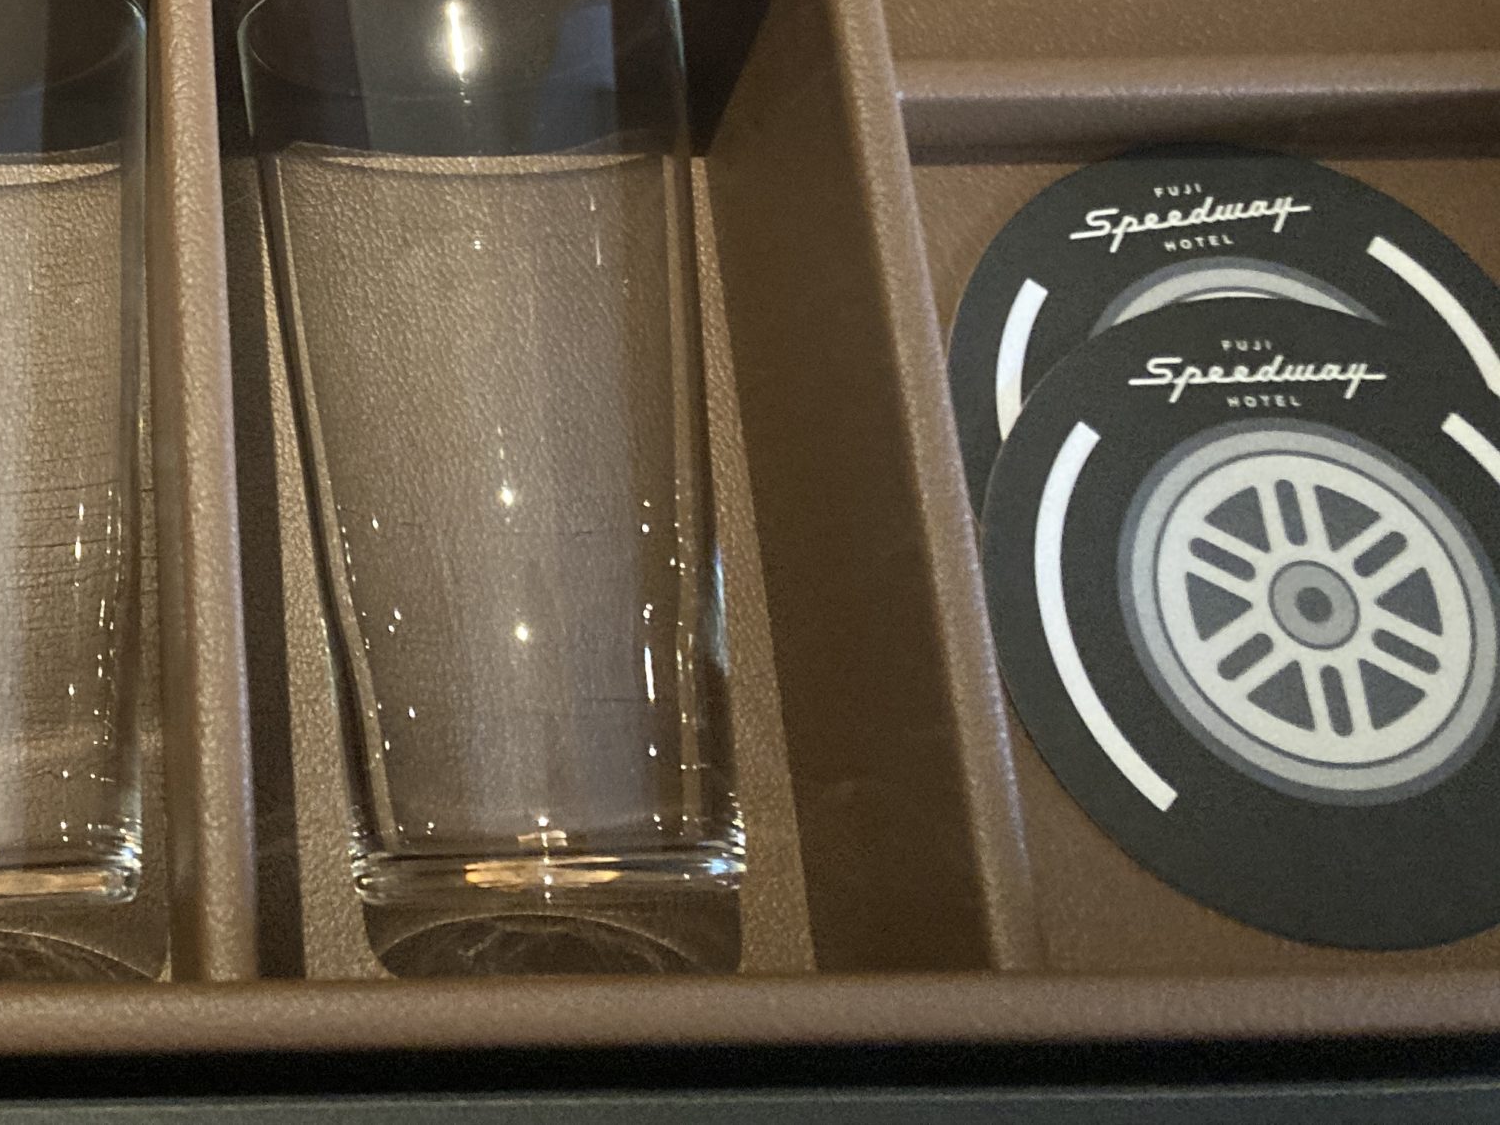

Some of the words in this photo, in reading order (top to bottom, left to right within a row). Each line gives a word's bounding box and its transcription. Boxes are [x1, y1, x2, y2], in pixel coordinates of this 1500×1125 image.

[1153, 183, 1202, 198] FUJI
[1069, 195, 1311, 253] Speedway
[1163, 234, 1235, 252] HOTEL
[1221, 339, 1272, 352] FUJI
[1128, 355, 1387, 404] Speedway
[1226, 394, 1302, 408] HOTEL
